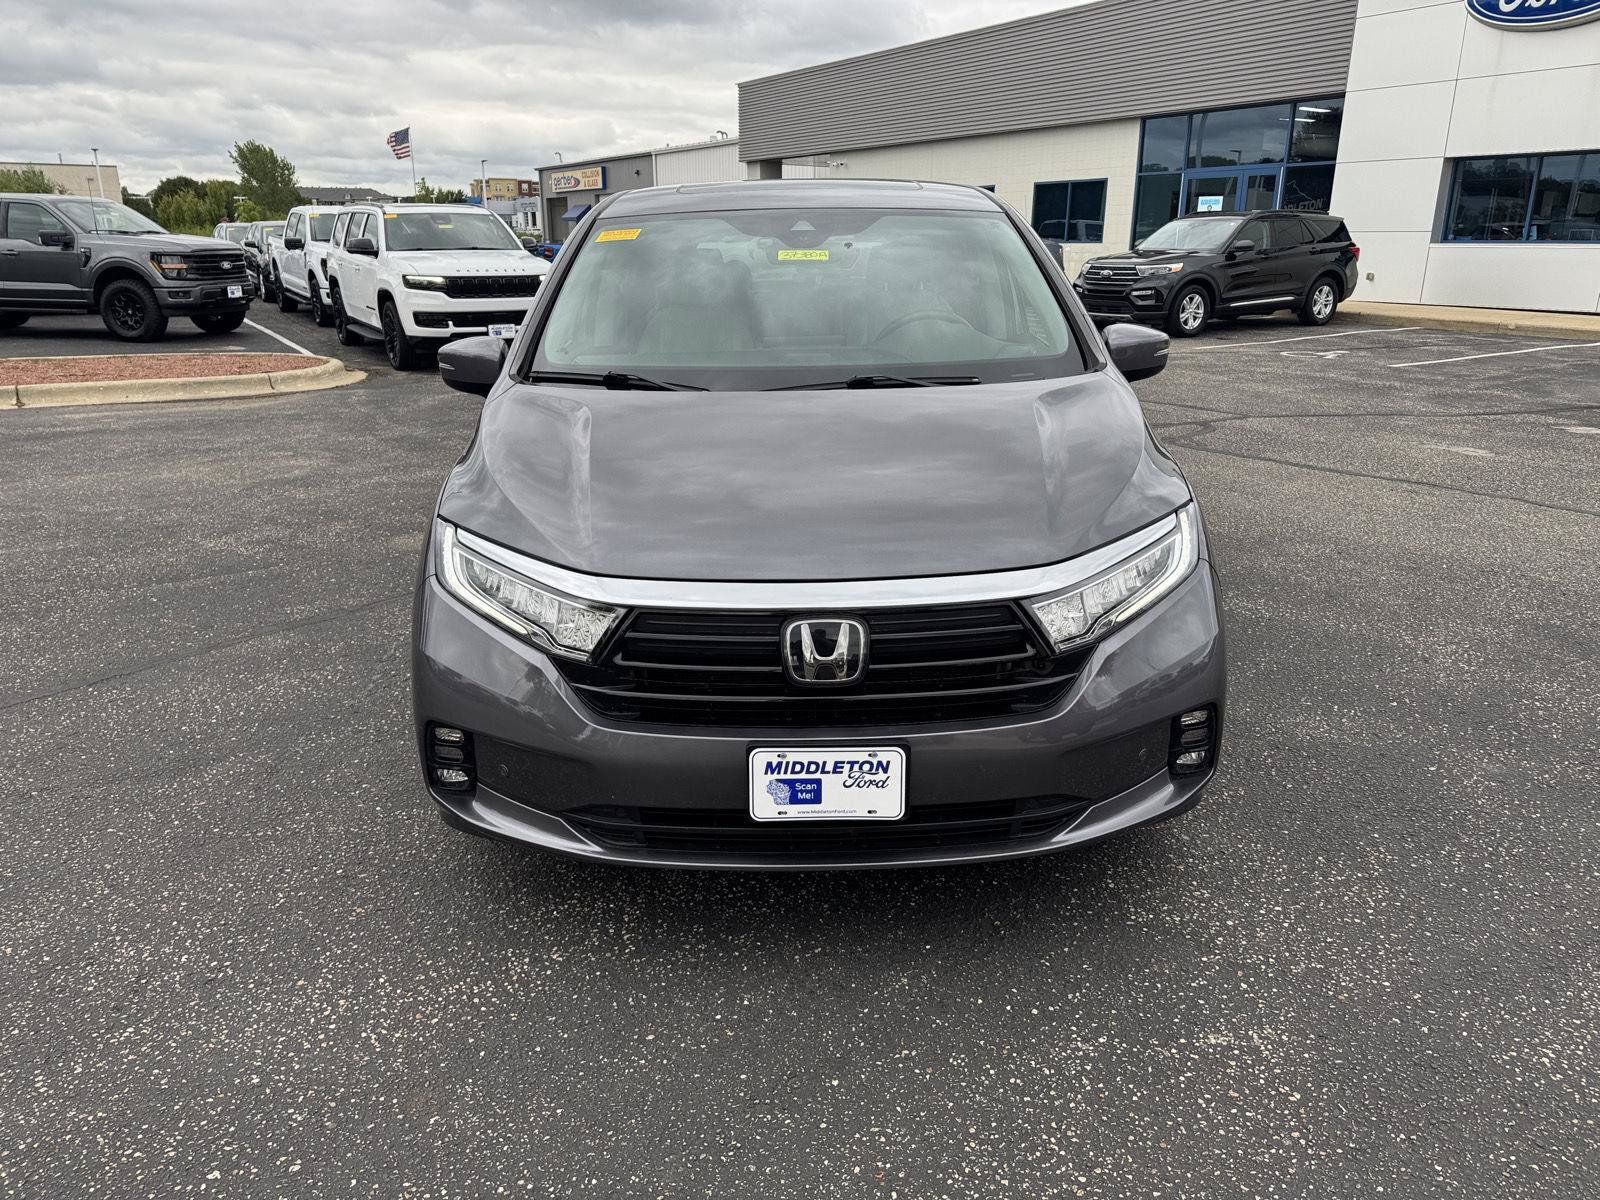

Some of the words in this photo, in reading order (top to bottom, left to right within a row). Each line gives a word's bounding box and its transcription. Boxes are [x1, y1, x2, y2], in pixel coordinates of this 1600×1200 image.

[764, 760, 891, 776] MIDDLETON
[842, 770, 890, 789] Ford
[795, 782, 817, 791] Scan
[797, 792, 814, 800] Me!
